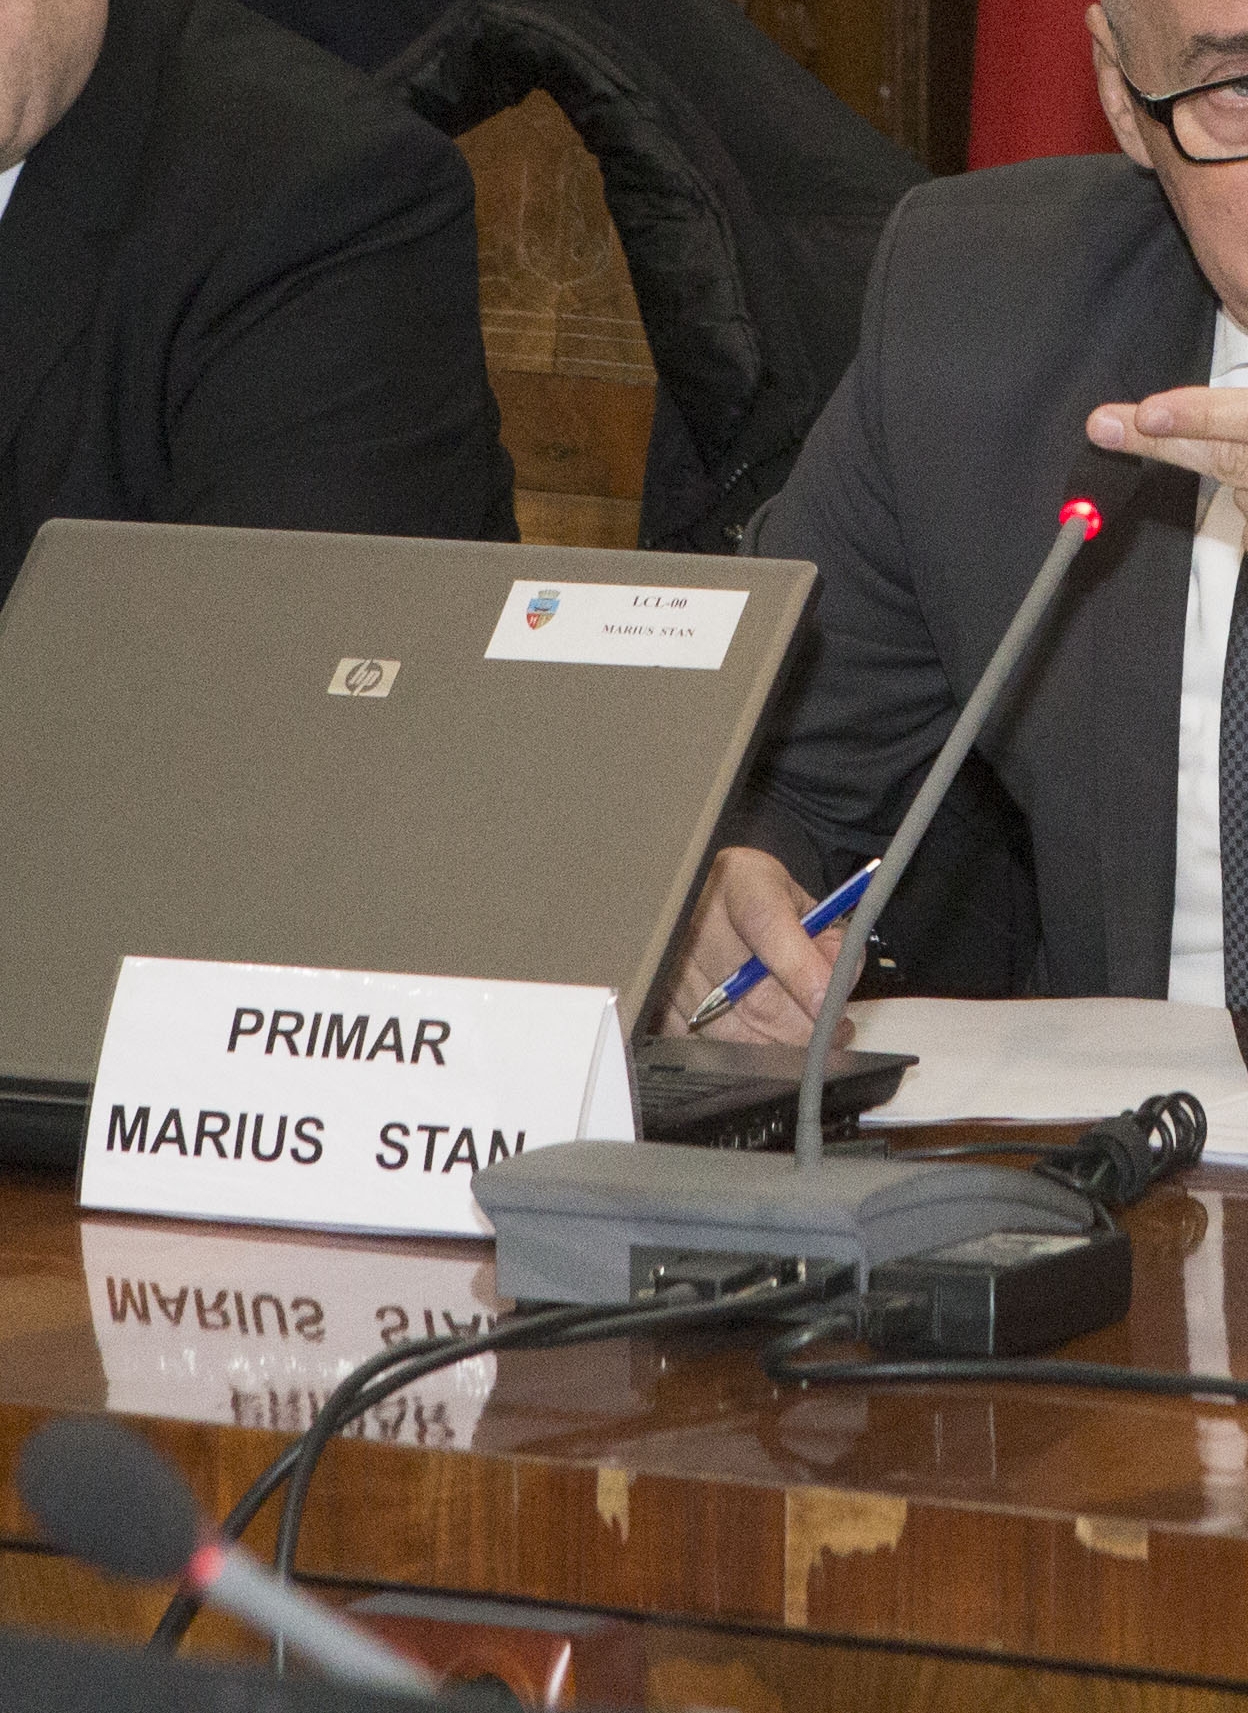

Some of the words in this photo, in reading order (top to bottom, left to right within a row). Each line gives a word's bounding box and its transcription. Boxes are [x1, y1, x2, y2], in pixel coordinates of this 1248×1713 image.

[602, 623, 654, 636] MARIUS
[660, 627, 697, 638] STAN
[227, 1007, 451, 1066] PRIMAR
[106, 1104, 325, 1164] MARIUS
